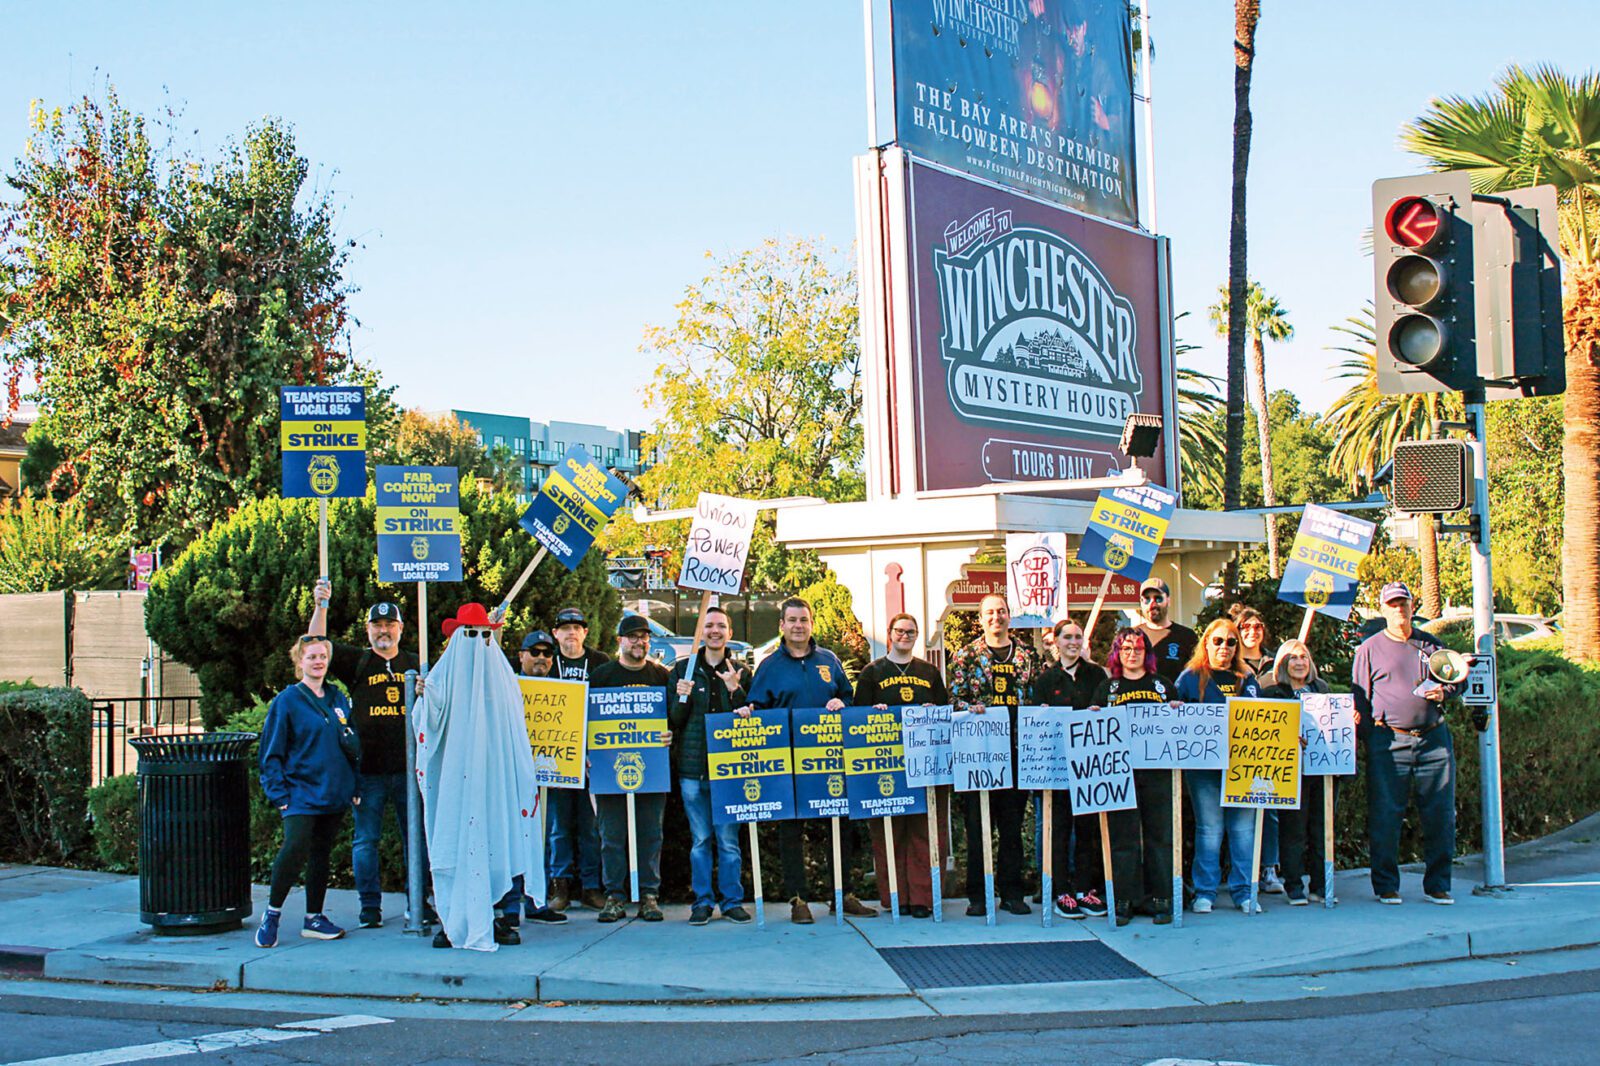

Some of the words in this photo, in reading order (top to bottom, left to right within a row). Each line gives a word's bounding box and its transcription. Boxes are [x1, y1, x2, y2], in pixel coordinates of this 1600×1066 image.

[916, 82, 952, 112] THE
[961, 98, 991, 126] BAY
[1000, 112, 1052, 148] AREA'S
[1059, 136, 1120, 176] PREMIER
[913, 106, 1020, 165] HALLOWEEN
[1027, 147, 1122, 200] DESTINATION
[950, 214, 991, 253] WELCOME
[998, 216, 1009, 233] TO
[942, 237, 1138, 384] WINCHESTER
[284, 392, 362, 404] TEAMSTERS
[964, 372, 1060, 411] MYSTERY
[1068, 390, 1128, 421] HOUSE
[294, 404, 328, 416] LOCAL
[330, 404, 350, 416] 856
[314, 424, 332, 432] ON
[288, 434, 358, 446] STRIKE
[1013, 449, 1054, 478] TOURS
[1059, 456, 1093, 480] DAILY
[404, 472, 432, 482] FAIR
[566, 458, 618, 504] CONTRACT
[384, 483, 452, 493] CONTRACT
[401, 493, 436, 503] NOW!
[572, 492, 586, 507] ON
[410, 508, 428, 518] ON
[548, 484, 599, 532] STRIKE
[1124, 508, 1140, 520] ON
[384, 518, 453, 532] STRIKE
[1098, 510, 1159, 539] STRIKE
[532, 518, 572, 556] TEAMSTERS
[534, 530, 552, 550] LOCAL
[1322, 544, 1338, 554] ON
[1024, 556, 1048, 571] RIP
[1298, 546, 1358, 574] STRIKE
[392, 562, 450, 572] TEAMSTERS
[403, 571, 425, 580] LOCAL
[1022, 572, 1048, 586] TOUR
[1022, 587, 1058, 607] SAFETY
[878, 676, 931, 690] TEAMSTERS
[522, 694, 567, 706] NFAIR
[590, 692, 663, 704] TEAMSTERS
[369, 706, 400, 716] LOCAL
[600, 704, 634, 715] LOCAL
[634, 702, 654, 714] 856
[1130, 705, 1170, 718] THIS
[1178, 705, 1224, 718] HOUSE
[525, 711, 563, 724] ABOR
[732, 718, 762, 728] FAIR
[820, 714, 842, 724] FAI
[867, 714, 894, 724] FAIR
[1023, 716, 1050, 728] There
[1234, 708, 1288, 725] UNFAIR
[1320, 712, 1338, 726] OF
[618, 722, 636, 730] ON
[714, 725, 782, 740] CONTRACT
[800, 724, 842, 735] CONTR
[952, 720, 1010, 738] AFFORDABLE
[1070, 716, 1122, 748] FAIR
[1131, 724, 1165, 736] RUNS
[1171, 724, 1188, 735] ON
[1194, 724, 1222, 735] OUR
[527, 730, 579, 743] ACTICE
[594, 730, 662, 746] STRIKE
[732, 736, 766, 748] NOW!
[865, 732, 900, 744] NOW!
[1232, 730, 1280, 742] LABOR
[1306, 727, 1352, 746] FAIR
[531, 745, 576, 760] TRIKE
[741, 752, 758, 762] ON
[826, 748, 842, 757] ON
[875, 748, 892, 758] ON
[954, 751, 1010, 764] HEALTHCARE
[1144, 740, 1220, 762] LABOR
[1230, 744, 1296, 762] PRACTICE
[852, 756, 906, 772] STRIK
[1310, 749, 1351, 767] PAY?
[716, 759, 785, 776] STRIKE
[801, 758, 845, 772] STRI
[908, 757, 922, 778] Us
[1070, 750, 1130, 780] WAGES
[968, 766, 1006, 789] NOW
[1230, 765, 1293, 782] STRIKE
[1076, 776, 1130, 808] NOW
[860, 796, 914, 809] TEAMSTERS
[1226, 795, 1296, 804] TEAMSTERS
[725, 802, 782, 814] TEAMSTERS
[819, 807, 842, 816] LOCAL
[872, 806, 893, 816] LOCAL
[736, 812, 759, 822] LOCAL
